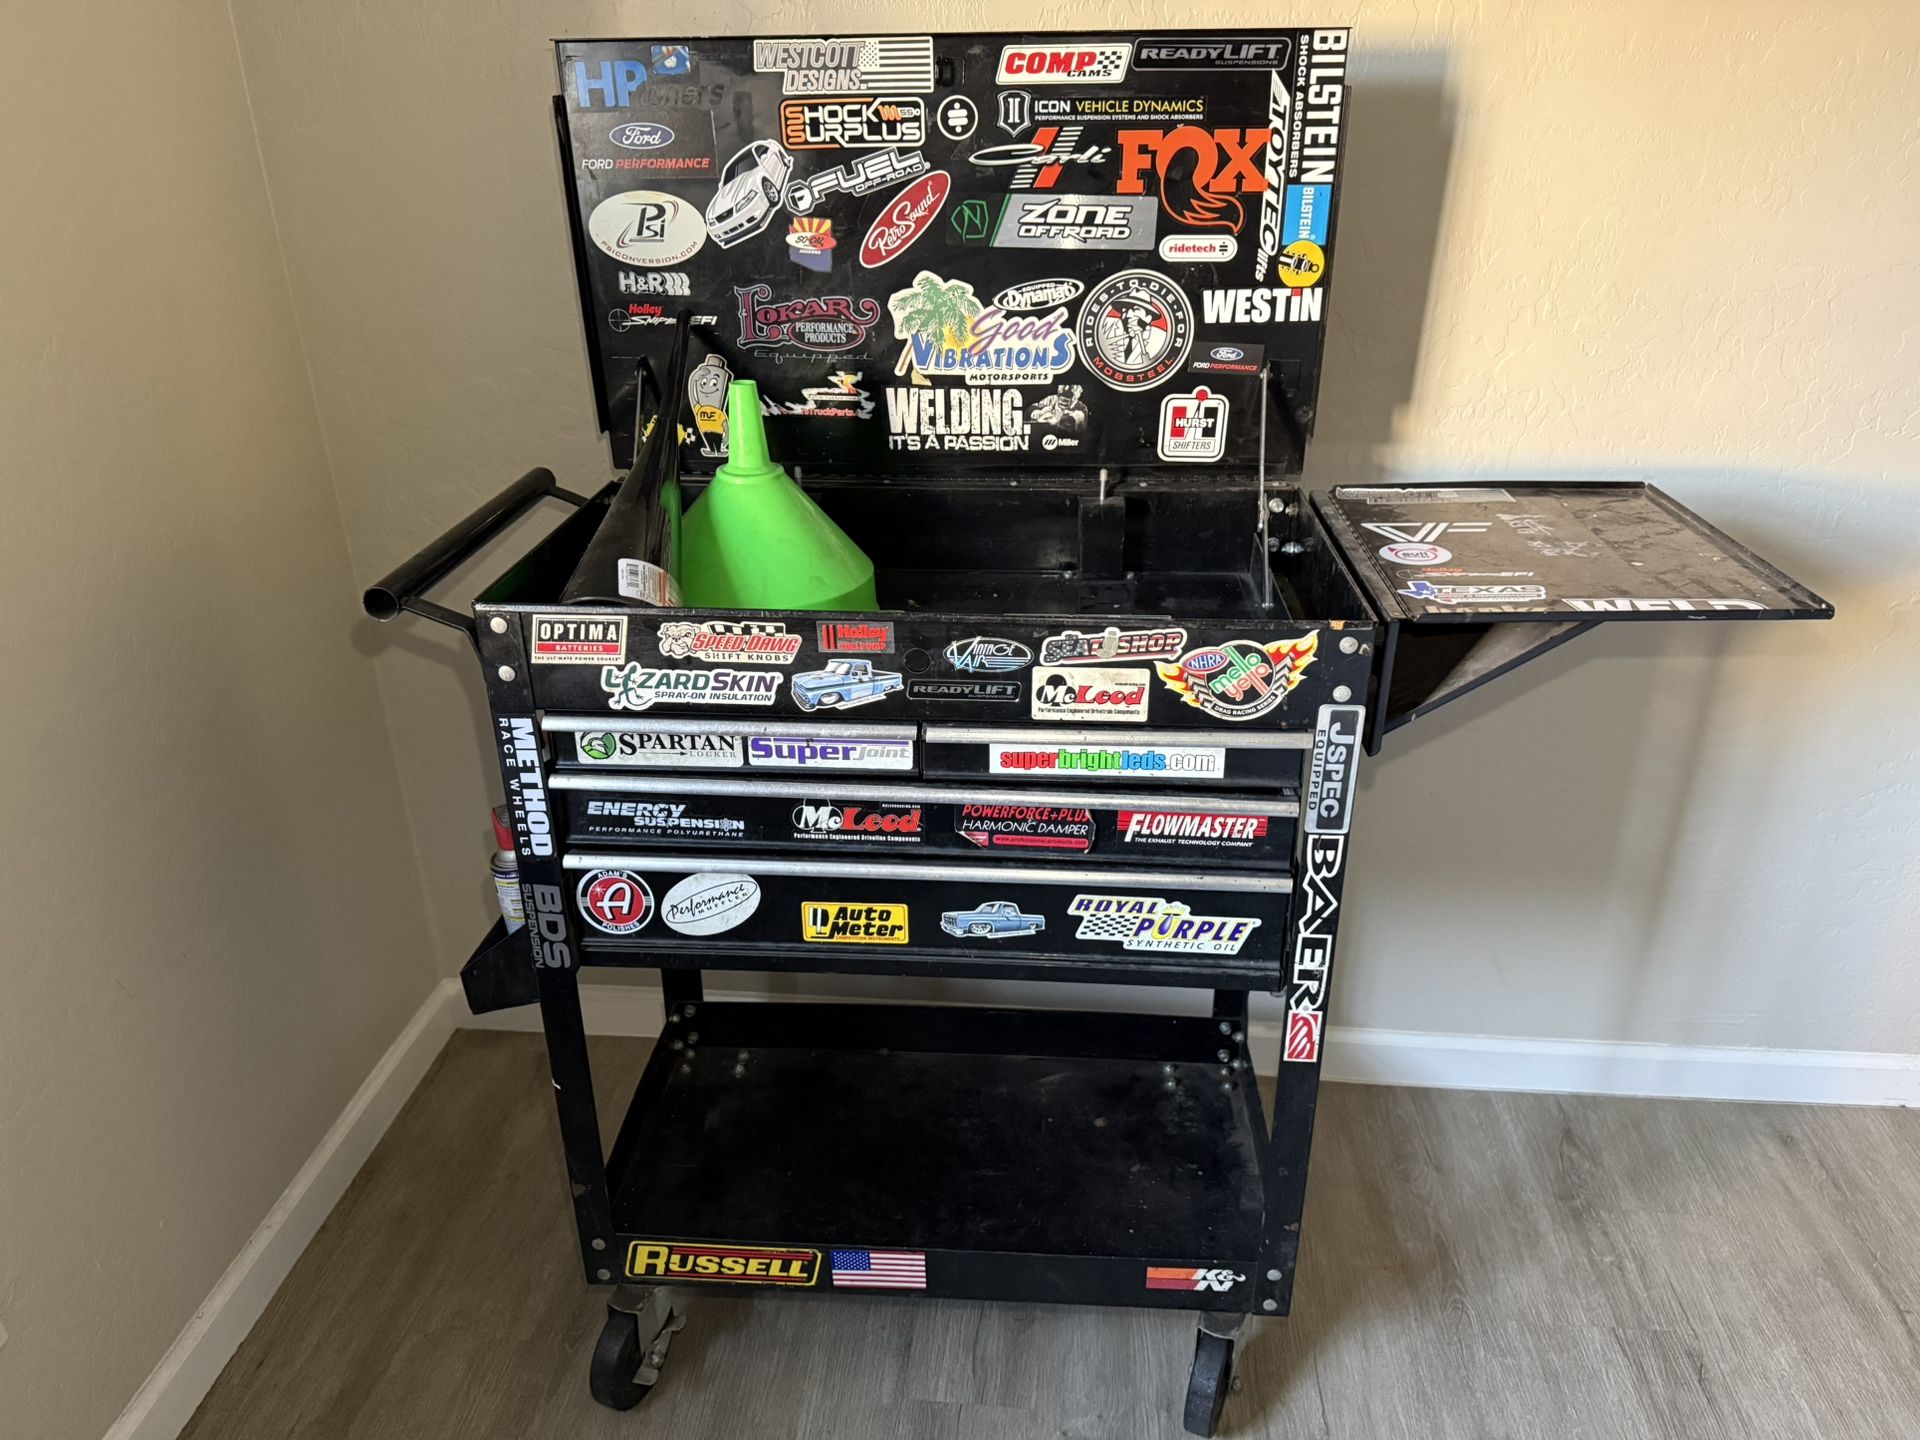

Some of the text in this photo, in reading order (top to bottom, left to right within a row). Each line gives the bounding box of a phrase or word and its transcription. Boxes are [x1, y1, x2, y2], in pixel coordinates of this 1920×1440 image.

[755, 40, 867, 70] WESTCOTT
[1004, 51, 1098, 75] COMP
[574, 60, 648, 108] HP
[1066, 69, 1112, 78] CAMS
[785, 104, 880, 125] SHOCK
[1034, 99, 1204, 113] ICON VEHICLE DYNAMICS
[1289, 34, 1309, 179] SHOCK ABSORBERS
[1300, 29, 1348, 183] BILSTEIN
[622, 126, 661, 145] Ford
[786, 122, 921, 144] SURPLUS
[581, 158, 710, 170] FORD PERFORMANCE
[968, 143, 1112, 166] Carli
[1115, 126, 1273, 193] FOX
[810, 151, 922, 199] FUEL
[855, 164, 922, 192] OFF-ROAD
[1018, 199, 1133, 225] ZONE
[1298, 186, 1315, 239] BILSTEIN
[1018, 225, 1131, 241] OFFROAD
[600, 240, 698, 265] PSICONVERSION.COM
[1168, 243, 1217, 253] ridetech
[618, 271, 670, 294] H&R
[1022, 282, 1056, 293] EQUIPPED
[1007, 283, 1072, 308] Dynamat
[622, 315, 718, 326] SNIPE EFI
[628, 304, 662, 316] Holley
[795, 322, 855, 333] PERFORMANCE
[804, 333, 847, 343] PRODUCTS
[968, 308, 1065, 356] Good
[754, 349, 873, 364] Equipped
[911, 331, 1073, 370] VIBRATIONS
[1216, 349, 1238, 359] Ford
[969, 373, 1049, 382] MOTORSPORTS
[1093, 356, 1173, 382] MOBSTEEL
[1210, 363, 1258, 371] PERFORMANCE
[1175, 418, 1214, 428] HURST
[888, 433, 1029, 451] IT'S A PASSION
[1058, 438, 1079, 447] Miller
[1172, 441, 1212, 450] SHIFTERS
[1436, 586, 1543, 594] TEXAS
[540, 622, 617, 641] OPTIMA
[555, 644, 604, 652] BATTERIES
[692, 632, 801, 654] SPEED DAWG
[1117, 632, 1182, 654] SHOP
[704, 653, 790, 663] SHIFT KNOBS
[1188, 654, 1226, 670] NHRA
[1208, 645, 1262, 694] mello
[1223, 663, 1272, 702] yello
[654, 690, 773, 702] SPRAY-ON INSULATION
[1040, 685, 1146, 705] McLeod
[1214, 695, 1276, 716] DRAG RACING SERIES
[618, 733, 736, 756] SPARTAN
[689, 750, 737, 758] LOCKER
[1000, 748, 1215, 772] superbrightleds.com
[1308, 729, 1326, 811] EQUIPPED
[1319, 722, 1355, 818] JSPEC
[498, 717, 532, 857] RACE WHEELS
[510, 717, 553, 857] METHOD
[586, 801, 687, 818] ENERGY
[798, 806, 922, 833] McLeod
[589, 826, 744, 837] PERFORMANCE POLYURETHANE
[794, 832, 829, 840] Performance
[962, 820, 1089, 835] HARMONIC DAMPER
[1124, 813, 1258, 842] FLOWMASTER
[597, 869, 628, 879] ADAM'S
[670, 883, 745, 920] Performance
[1074, 898, 1159, 915] ROYAL
[833, 906, 892, 922] Auto
[1290, 834, 1344, 1013] BAER
[521, 884, 545, 969] SUSPENSION
[531, 884, 572, 969] BDS
[602, 920, 640, 932] POLISHES
[829, 921, 904, 938] Meter
[1132, 917, 1251, 942] PURPLE
[1126, 939, 1237, 951] SYNTHETIC OIL
[633, 1244, 809, 1278] RUSSELL
